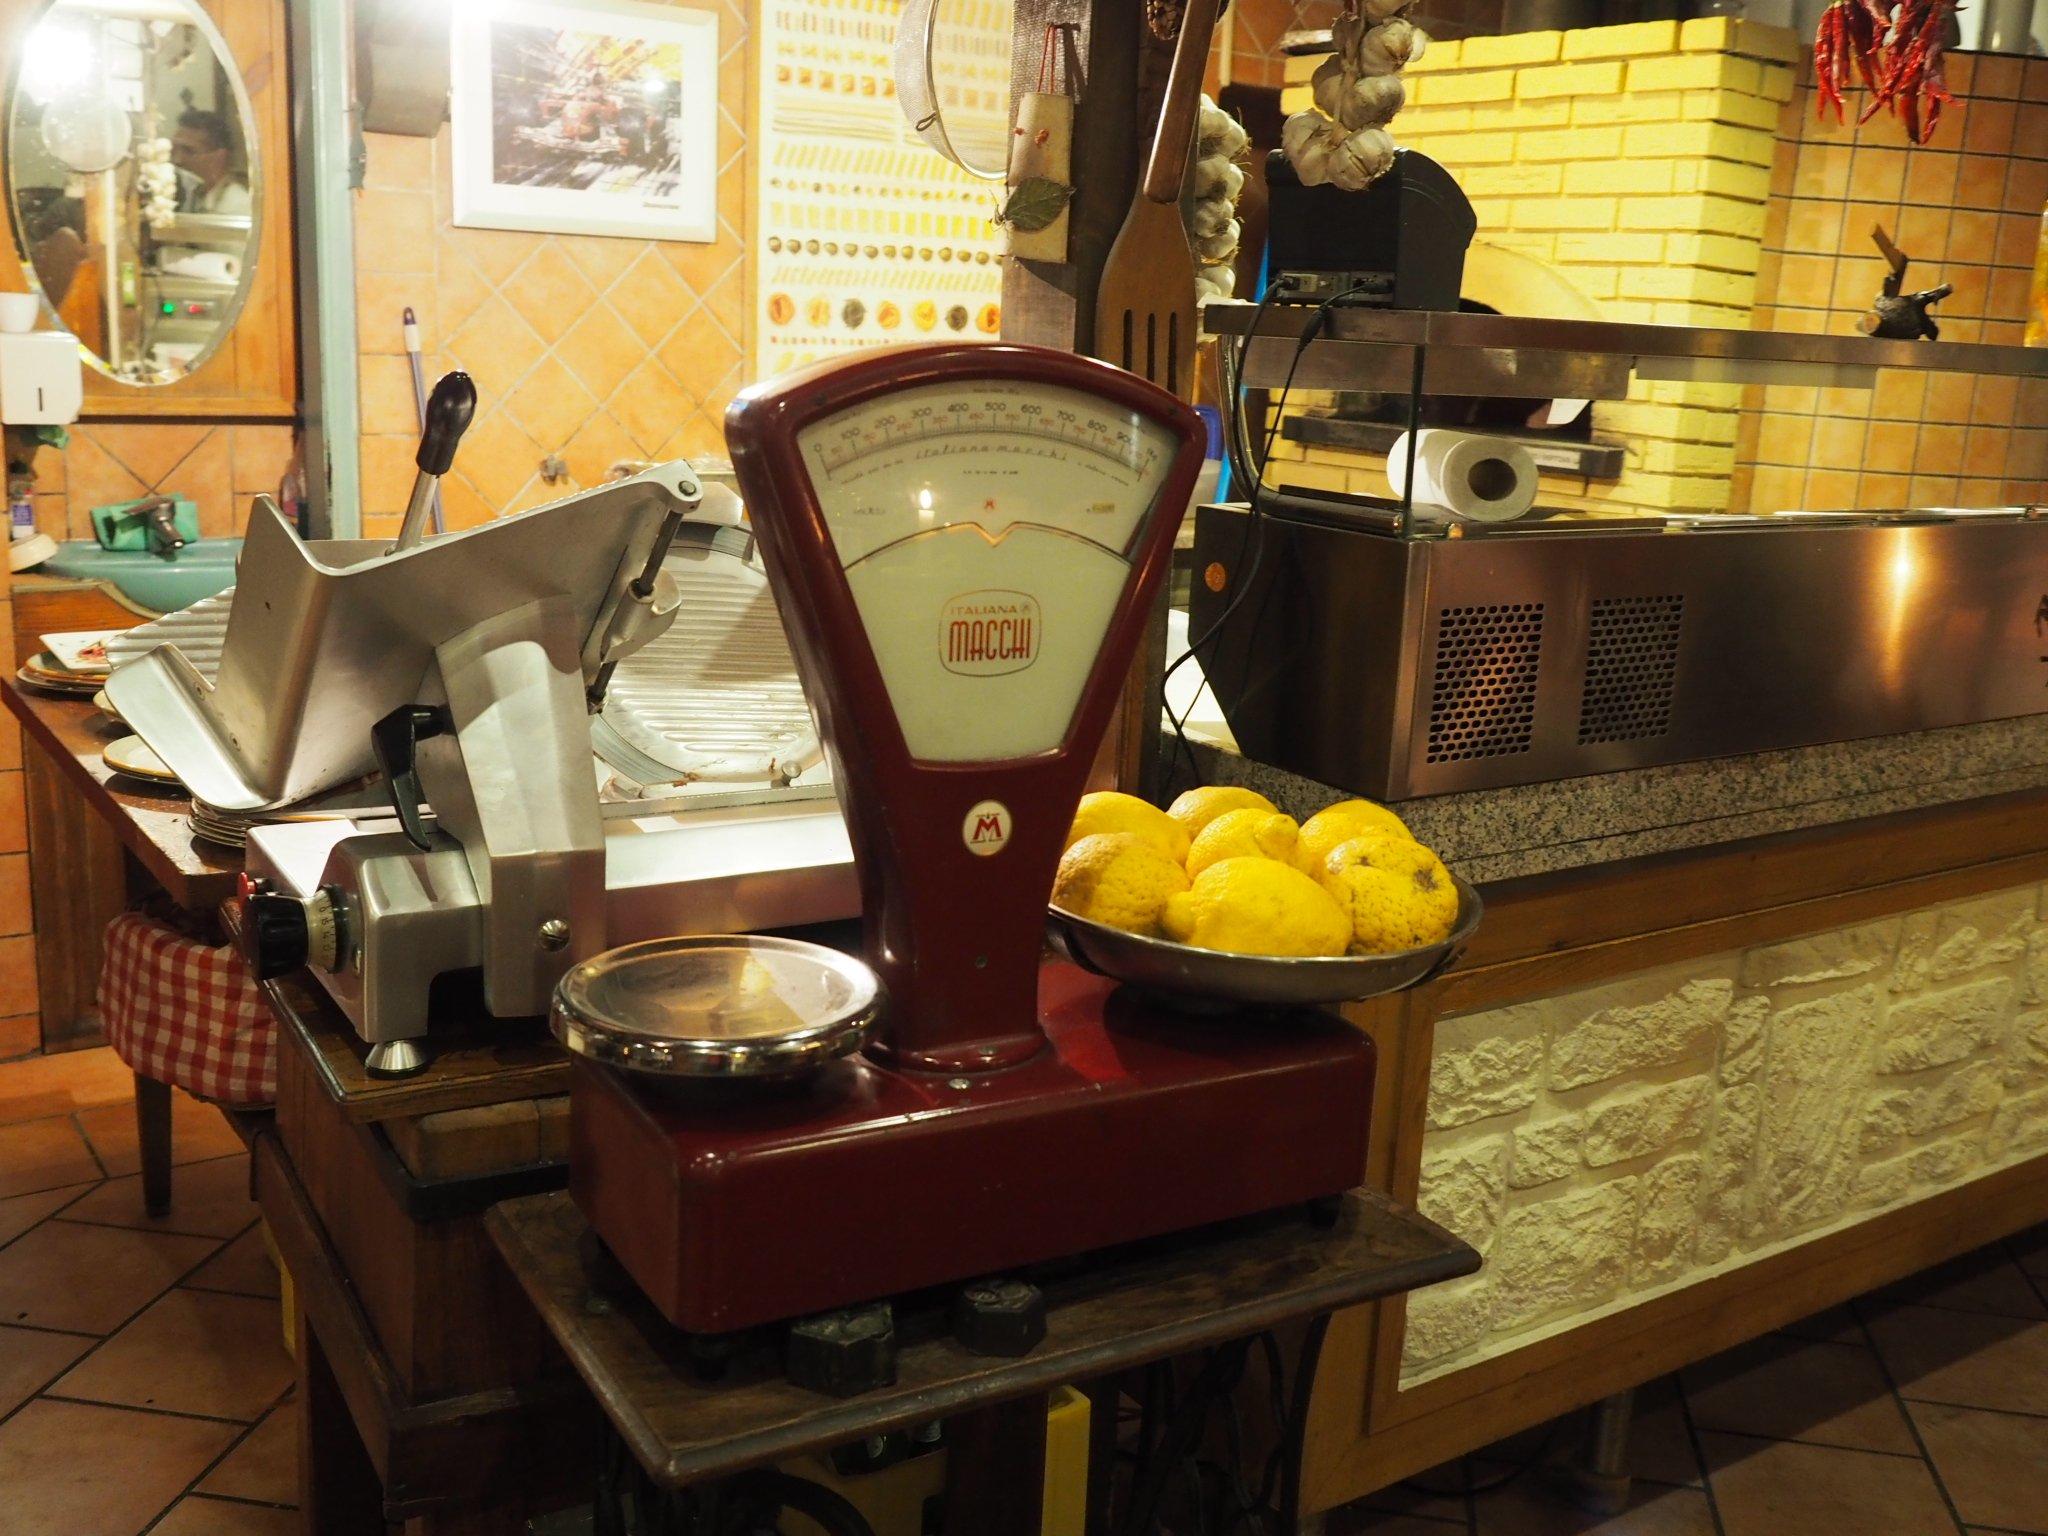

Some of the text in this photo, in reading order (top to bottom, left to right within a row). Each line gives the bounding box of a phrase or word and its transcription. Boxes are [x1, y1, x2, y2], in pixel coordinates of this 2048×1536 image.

[912, 407, 932, 418] 300
[947, 402, 969, 413] 400
[985, 402, 1007, 412] 500
[1021, 403, 1042, 415] 600
[1057, 410, 1076, 423] 700
[1087, 419, 1107, 433] 800
[950, 605, 1017, 615] ITALIANA
[948, 618, 1031, 662] MACCHI
